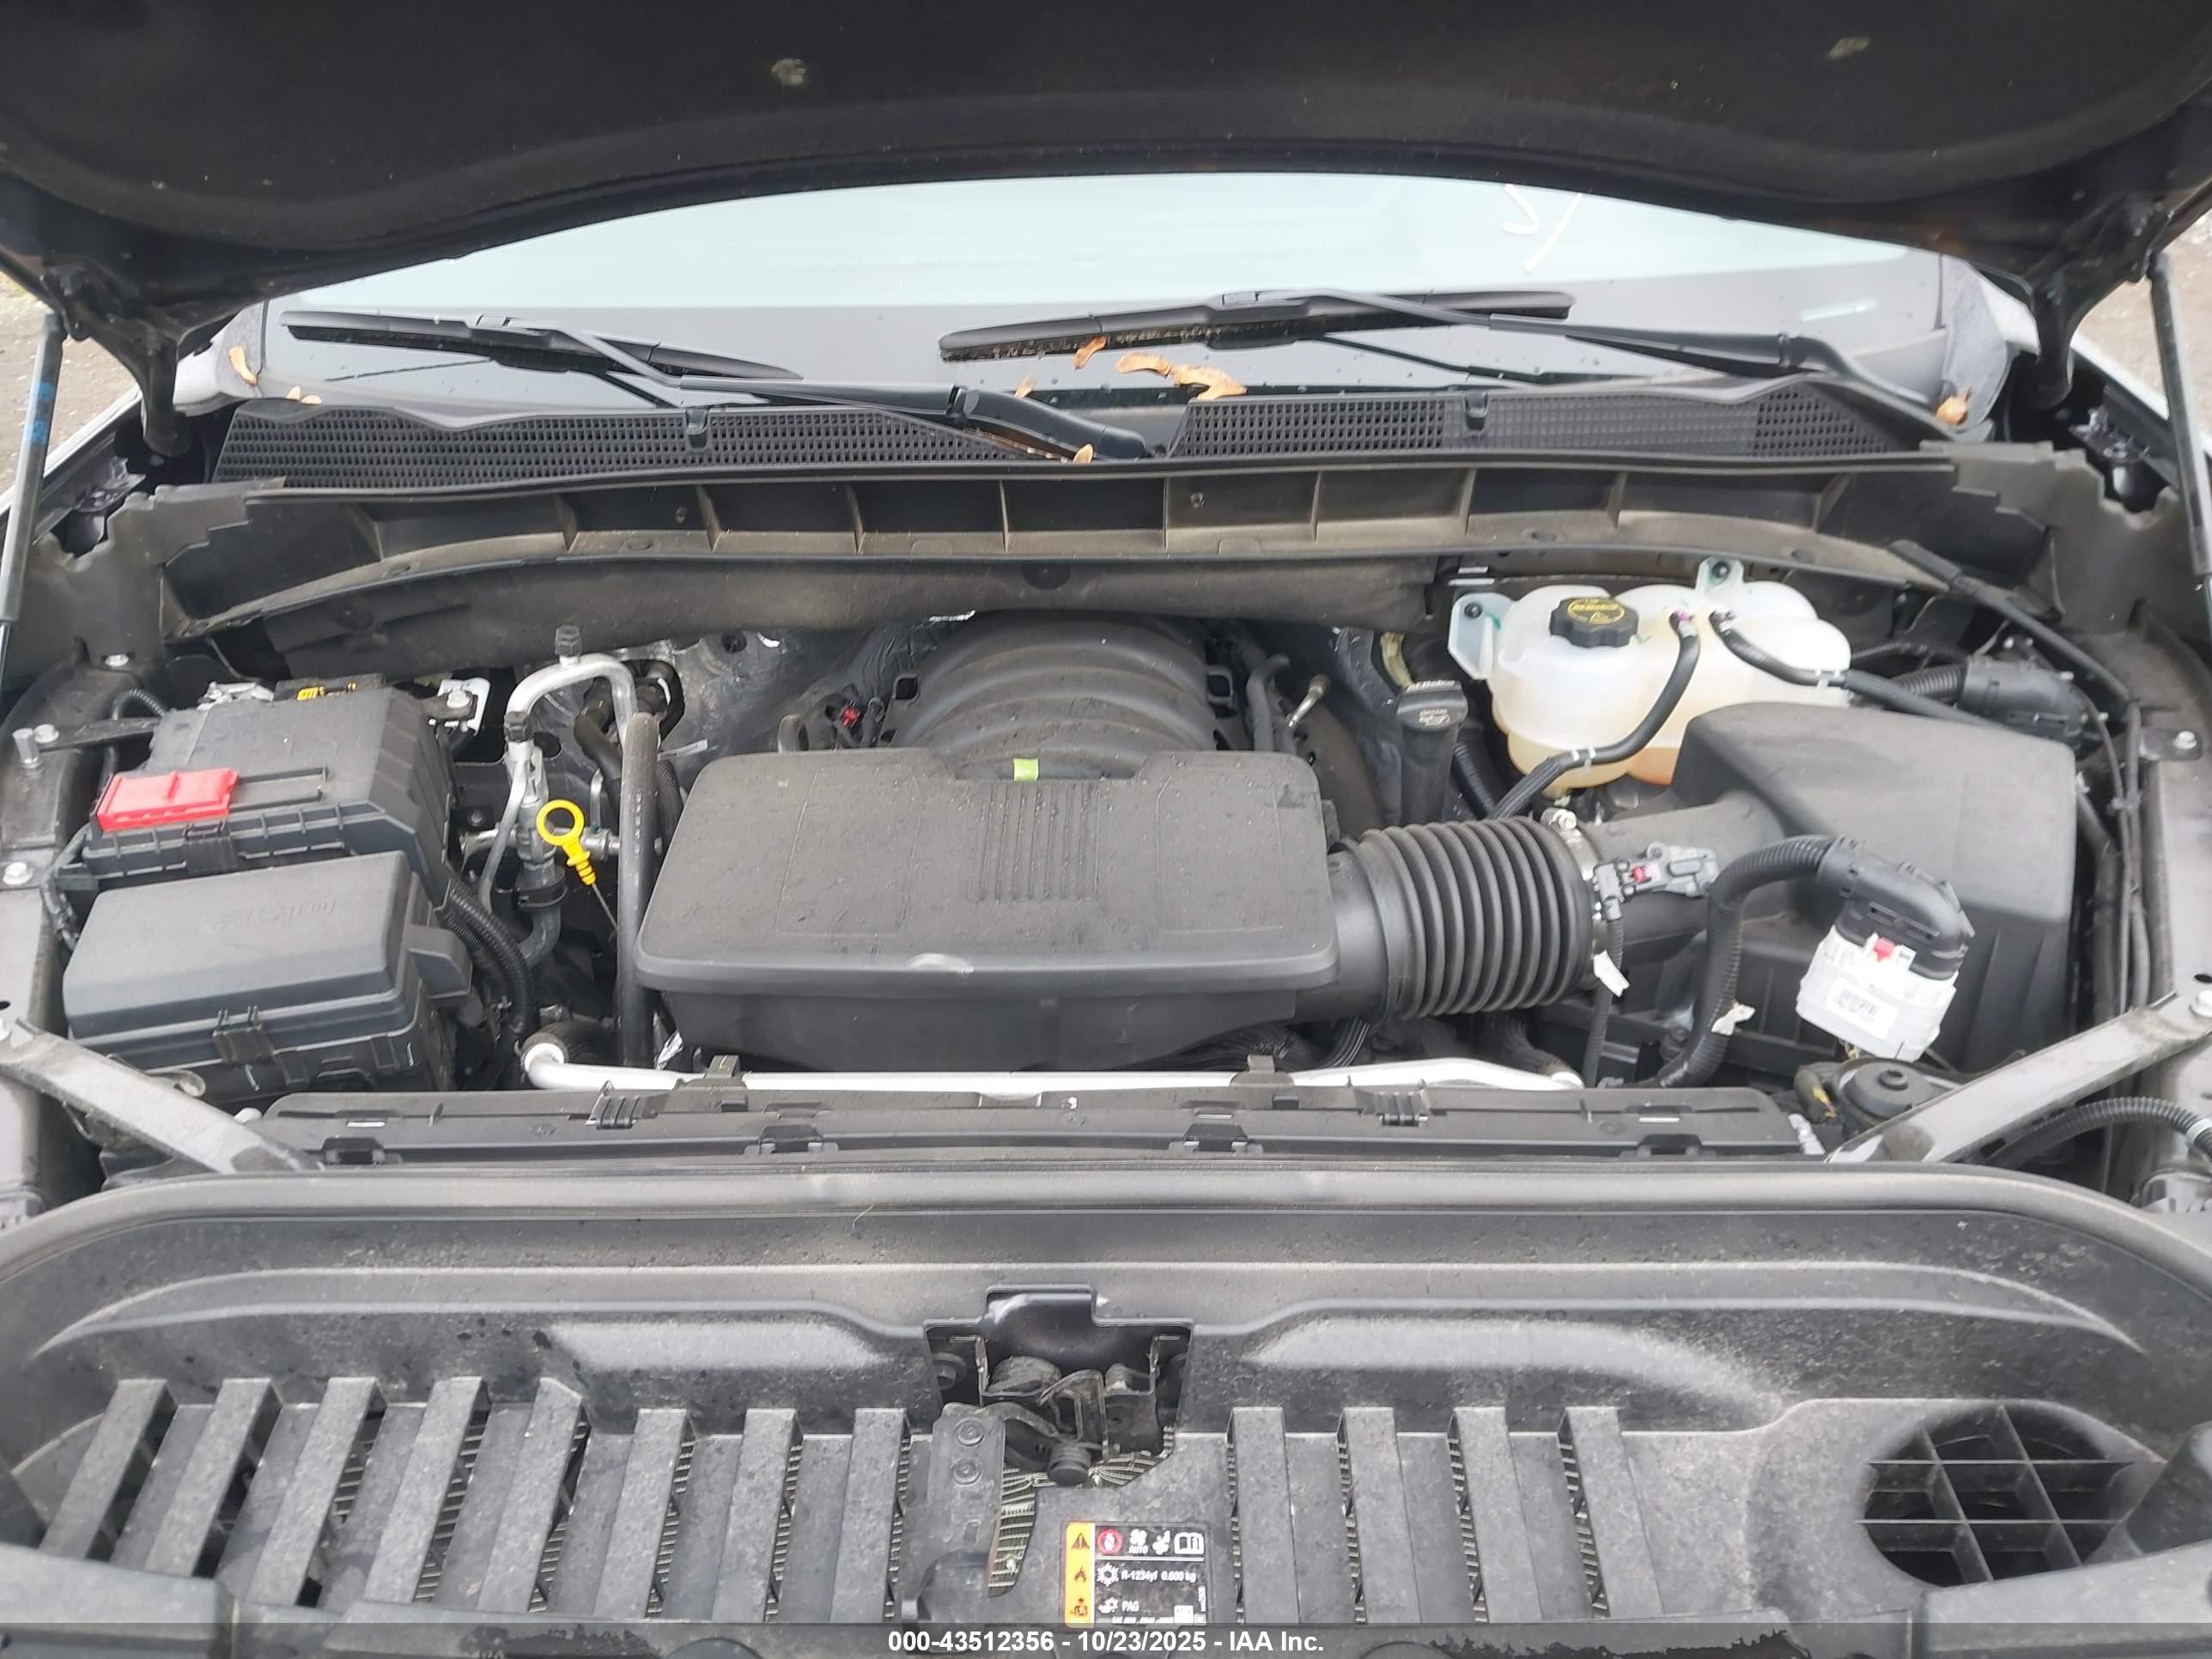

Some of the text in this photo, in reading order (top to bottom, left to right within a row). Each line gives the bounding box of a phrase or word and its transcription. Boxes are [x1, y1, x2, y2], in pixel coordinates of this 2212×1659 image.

[1121, 1570, 1158, 1583] R-1234yf
[1185, 1571, 1197, 1583] kg
[1121, 1600, 1140, 1612] PAG
